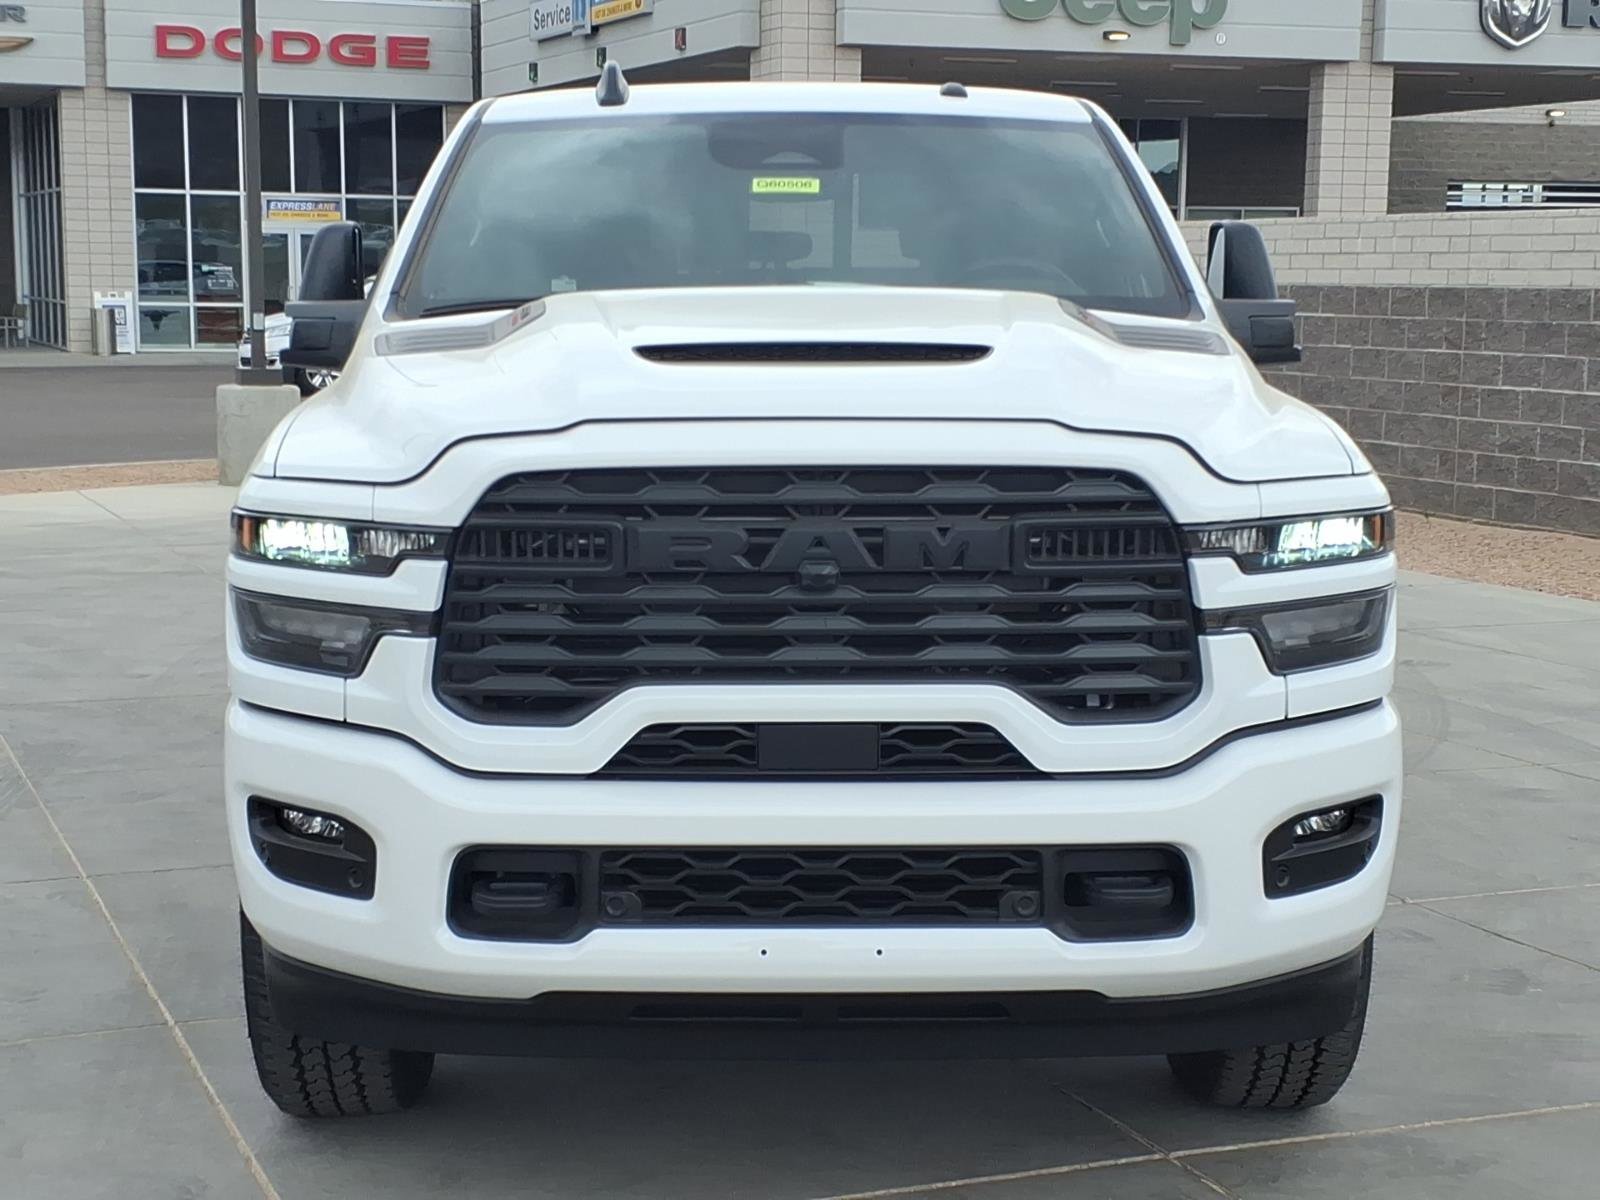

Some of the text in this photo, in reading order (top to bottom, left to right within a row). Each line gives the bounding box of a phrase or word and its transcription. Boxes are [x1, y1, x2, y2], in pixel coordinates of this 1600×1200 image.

[533, 4, 571, 30] Service
[154, 24, 431, 69] DODGE
[628, 526, 1008, 572] RAM
